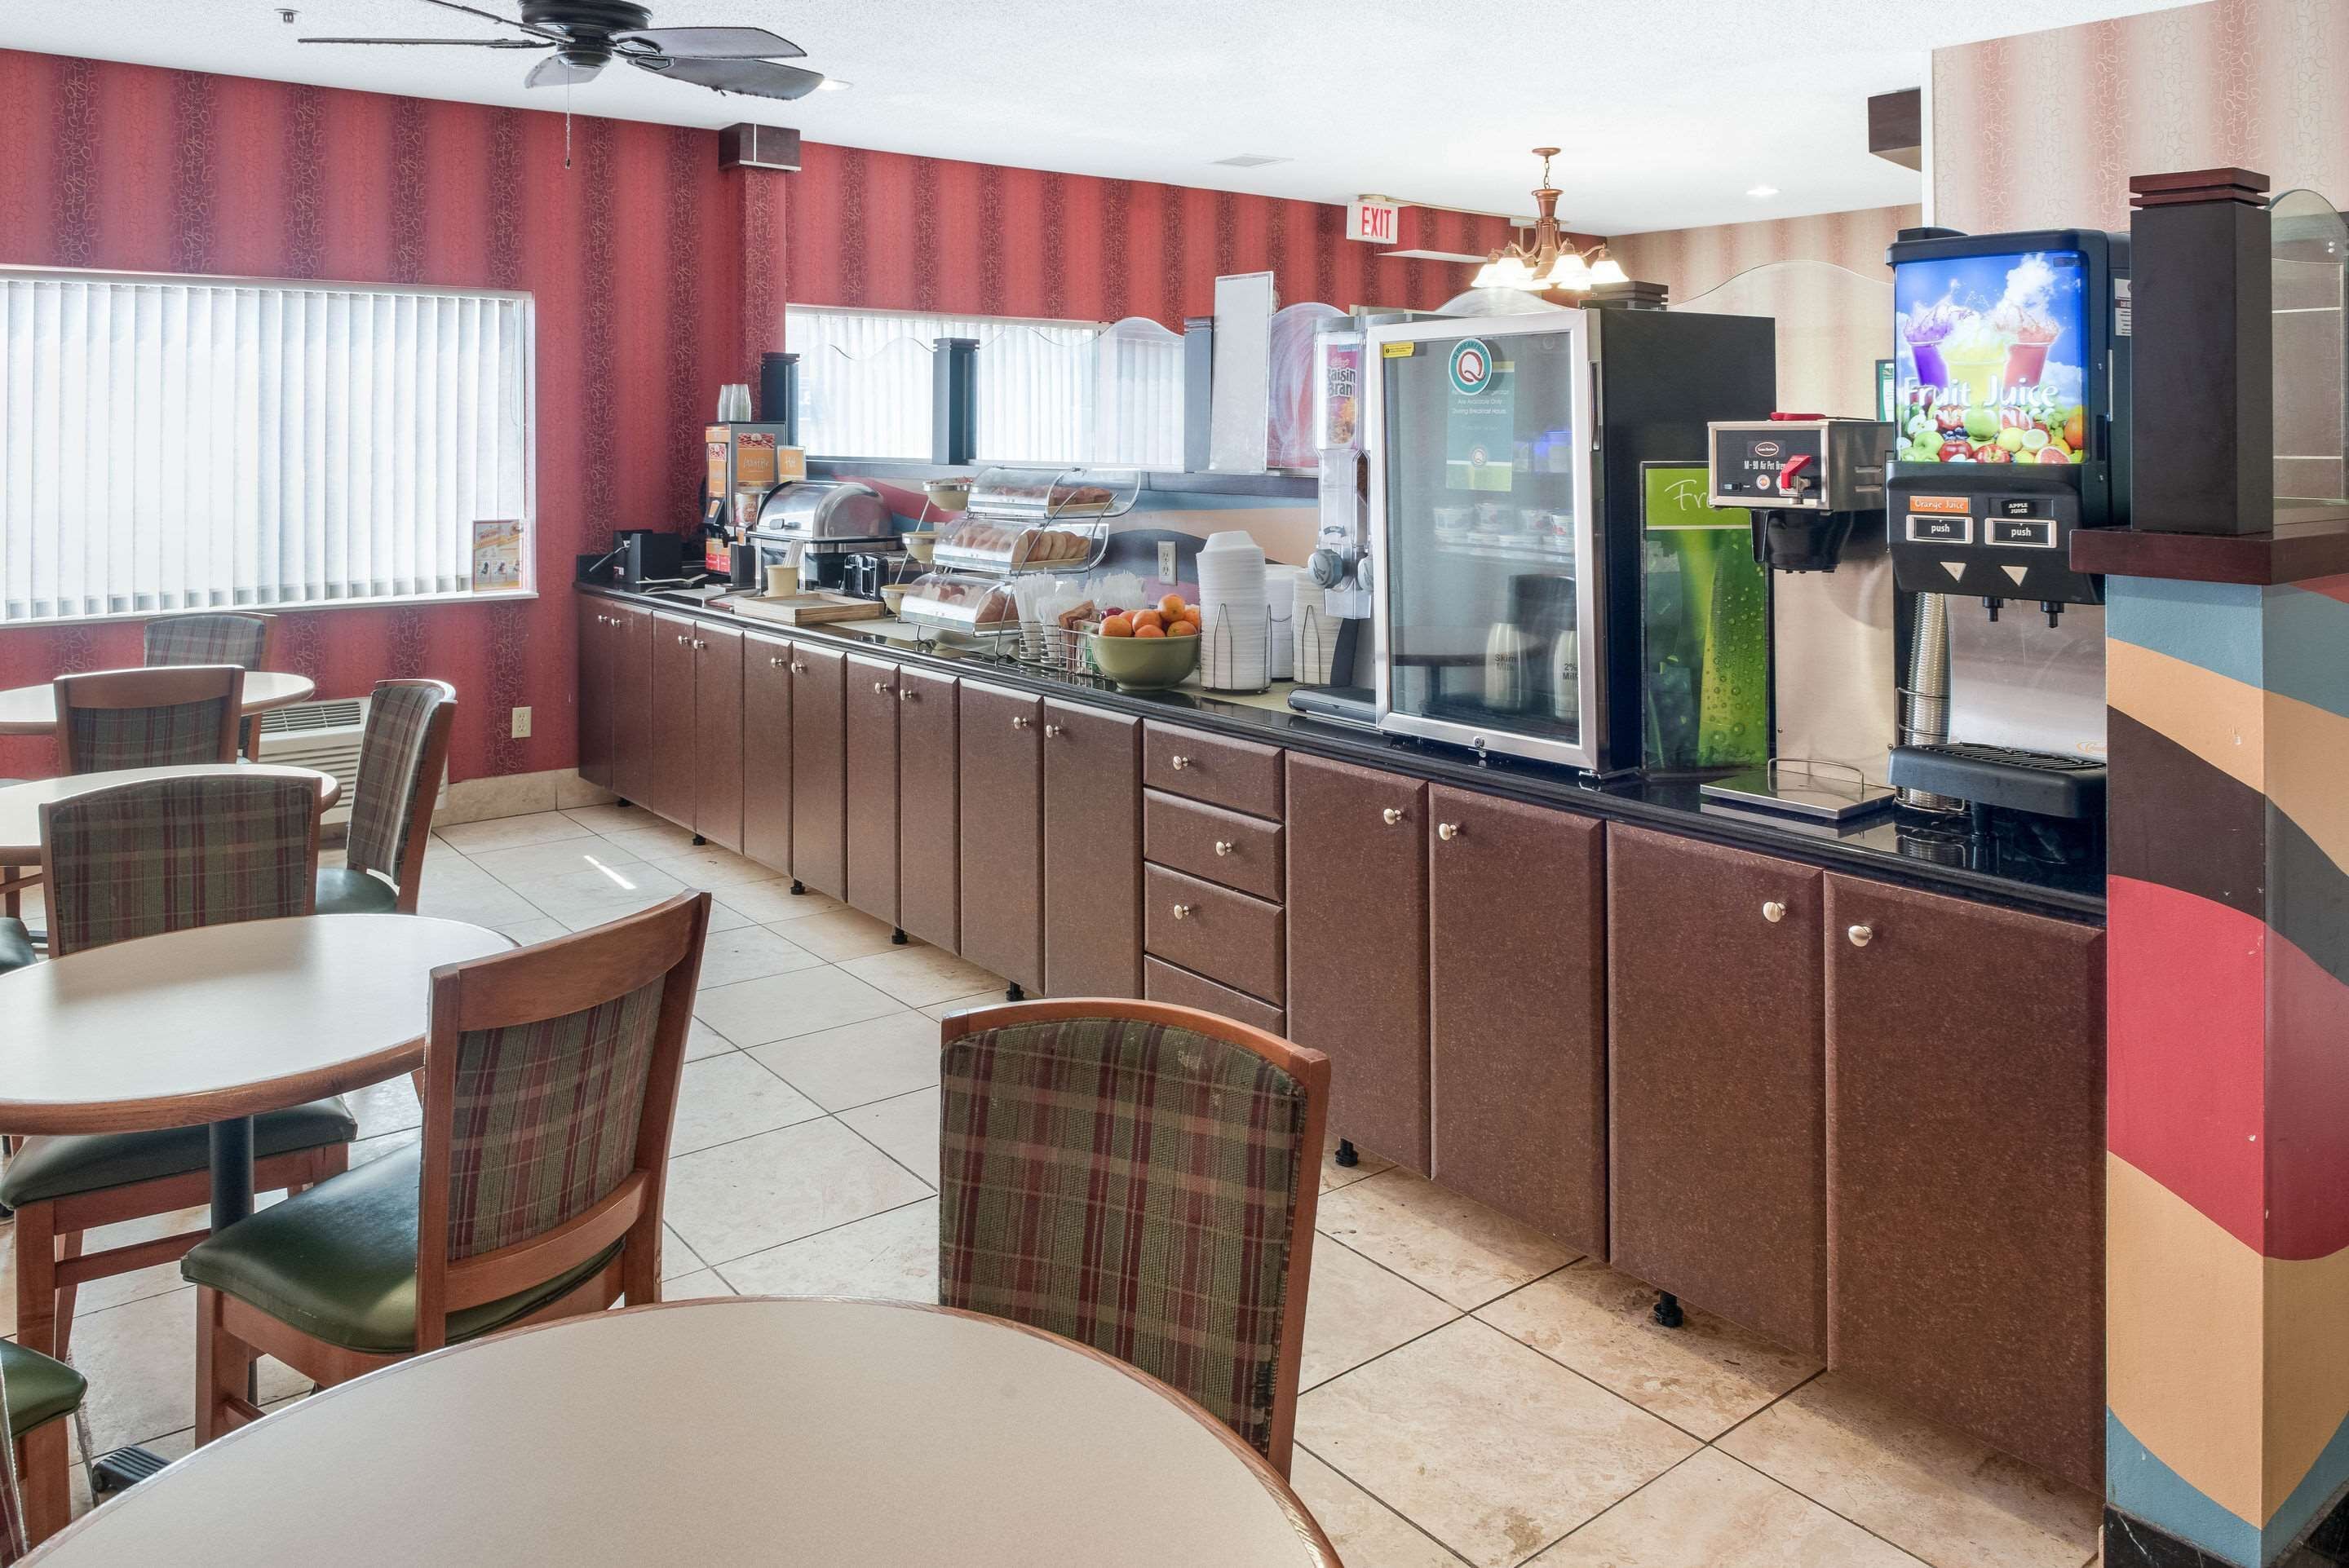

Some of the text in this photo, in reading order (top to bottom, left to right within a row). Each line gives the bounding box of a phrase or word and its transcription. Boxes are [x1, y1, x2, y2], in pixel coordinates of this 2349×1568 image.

[1361, 205, 1392, 239] EXIT
[1456, 341, 1487, 356] BREAKFAST
[1458, 351, 1486, 382] Q
[1903, 374, 2059, 408] Fruit Juice
[1767, 460, 1775, 470] Pot
[1914, 498, 1964, 510] Orange Juice
[1931, 524, 1950, 534] push
[2011, 527, 2032, 538] push
[1494, 653, 1516, 662] Skim
